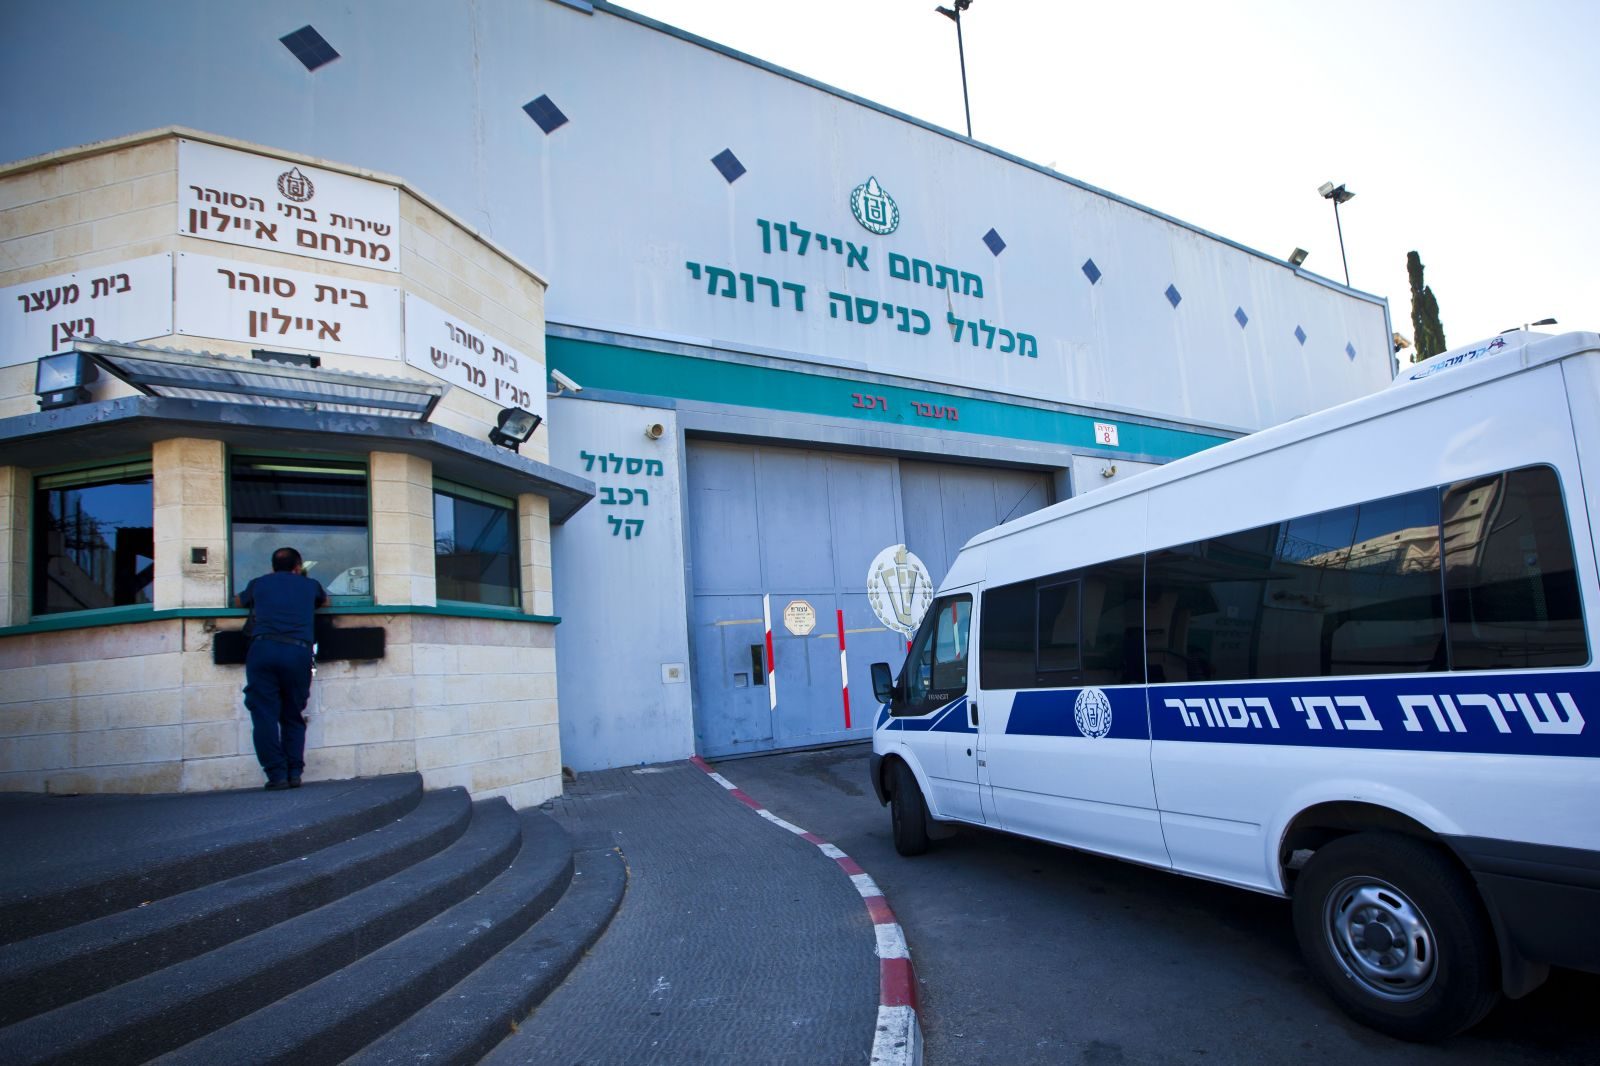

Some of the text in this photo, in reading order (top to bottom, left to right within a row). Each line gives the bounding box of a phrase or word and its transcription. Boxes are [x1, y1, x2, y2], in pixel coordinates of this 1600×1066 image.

[189, 185, 391, 237] שירות בתי הסוהר
[189, 206, 391, 263] מתחם איילון
[756, 218, 984, 299] מתחם איילון
[17, 272, 132, 313] בית מעצר
[217, 268, 369, 309] בית סוהר
[248, 307, 342, 342] איילון
[686, 261, 1038, 359] מכלול כניסה דרומי
[51, 317, 95, 352] ניצן
[444, 321, 519, 374] בית סוהר
[852, 392, 959, 421] מעבר רכב
[1104, 432, 1111, 443] 8
[579, 450, 664, 477] מסלול
[599, 486, 649, 506] רכב
[607, 514, 645, 541] קל
[1163, 692, 1586, 735] שירות בתי הסוהר
